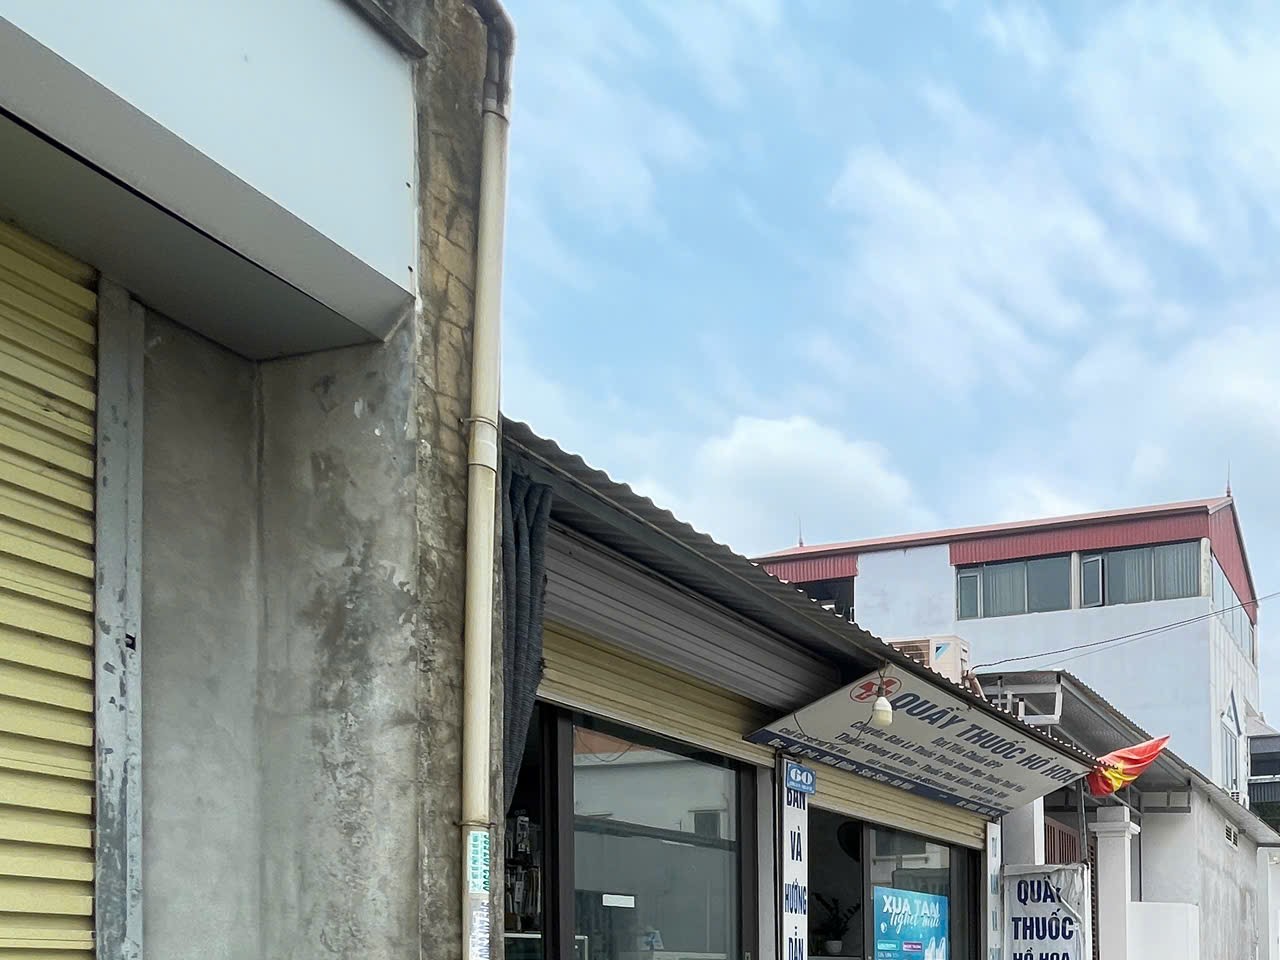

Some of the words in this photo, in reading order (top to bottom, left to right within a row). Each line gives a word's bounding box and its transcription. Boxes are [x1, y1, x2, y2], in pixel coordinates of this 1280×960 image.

[956, 724, 1026, 759] THUỐC
[1040, 764, 1080, 784] HOA
[790, 768, 813, 785] 60
[790, 826, 802, 862] VÀ
[785, 878, 807, 915] HƯỚNG
[883, 895, 911, 915] XUA
[914, 899, 940, 918] TAN
[1012, 908, 1074, 940] THUỐC
